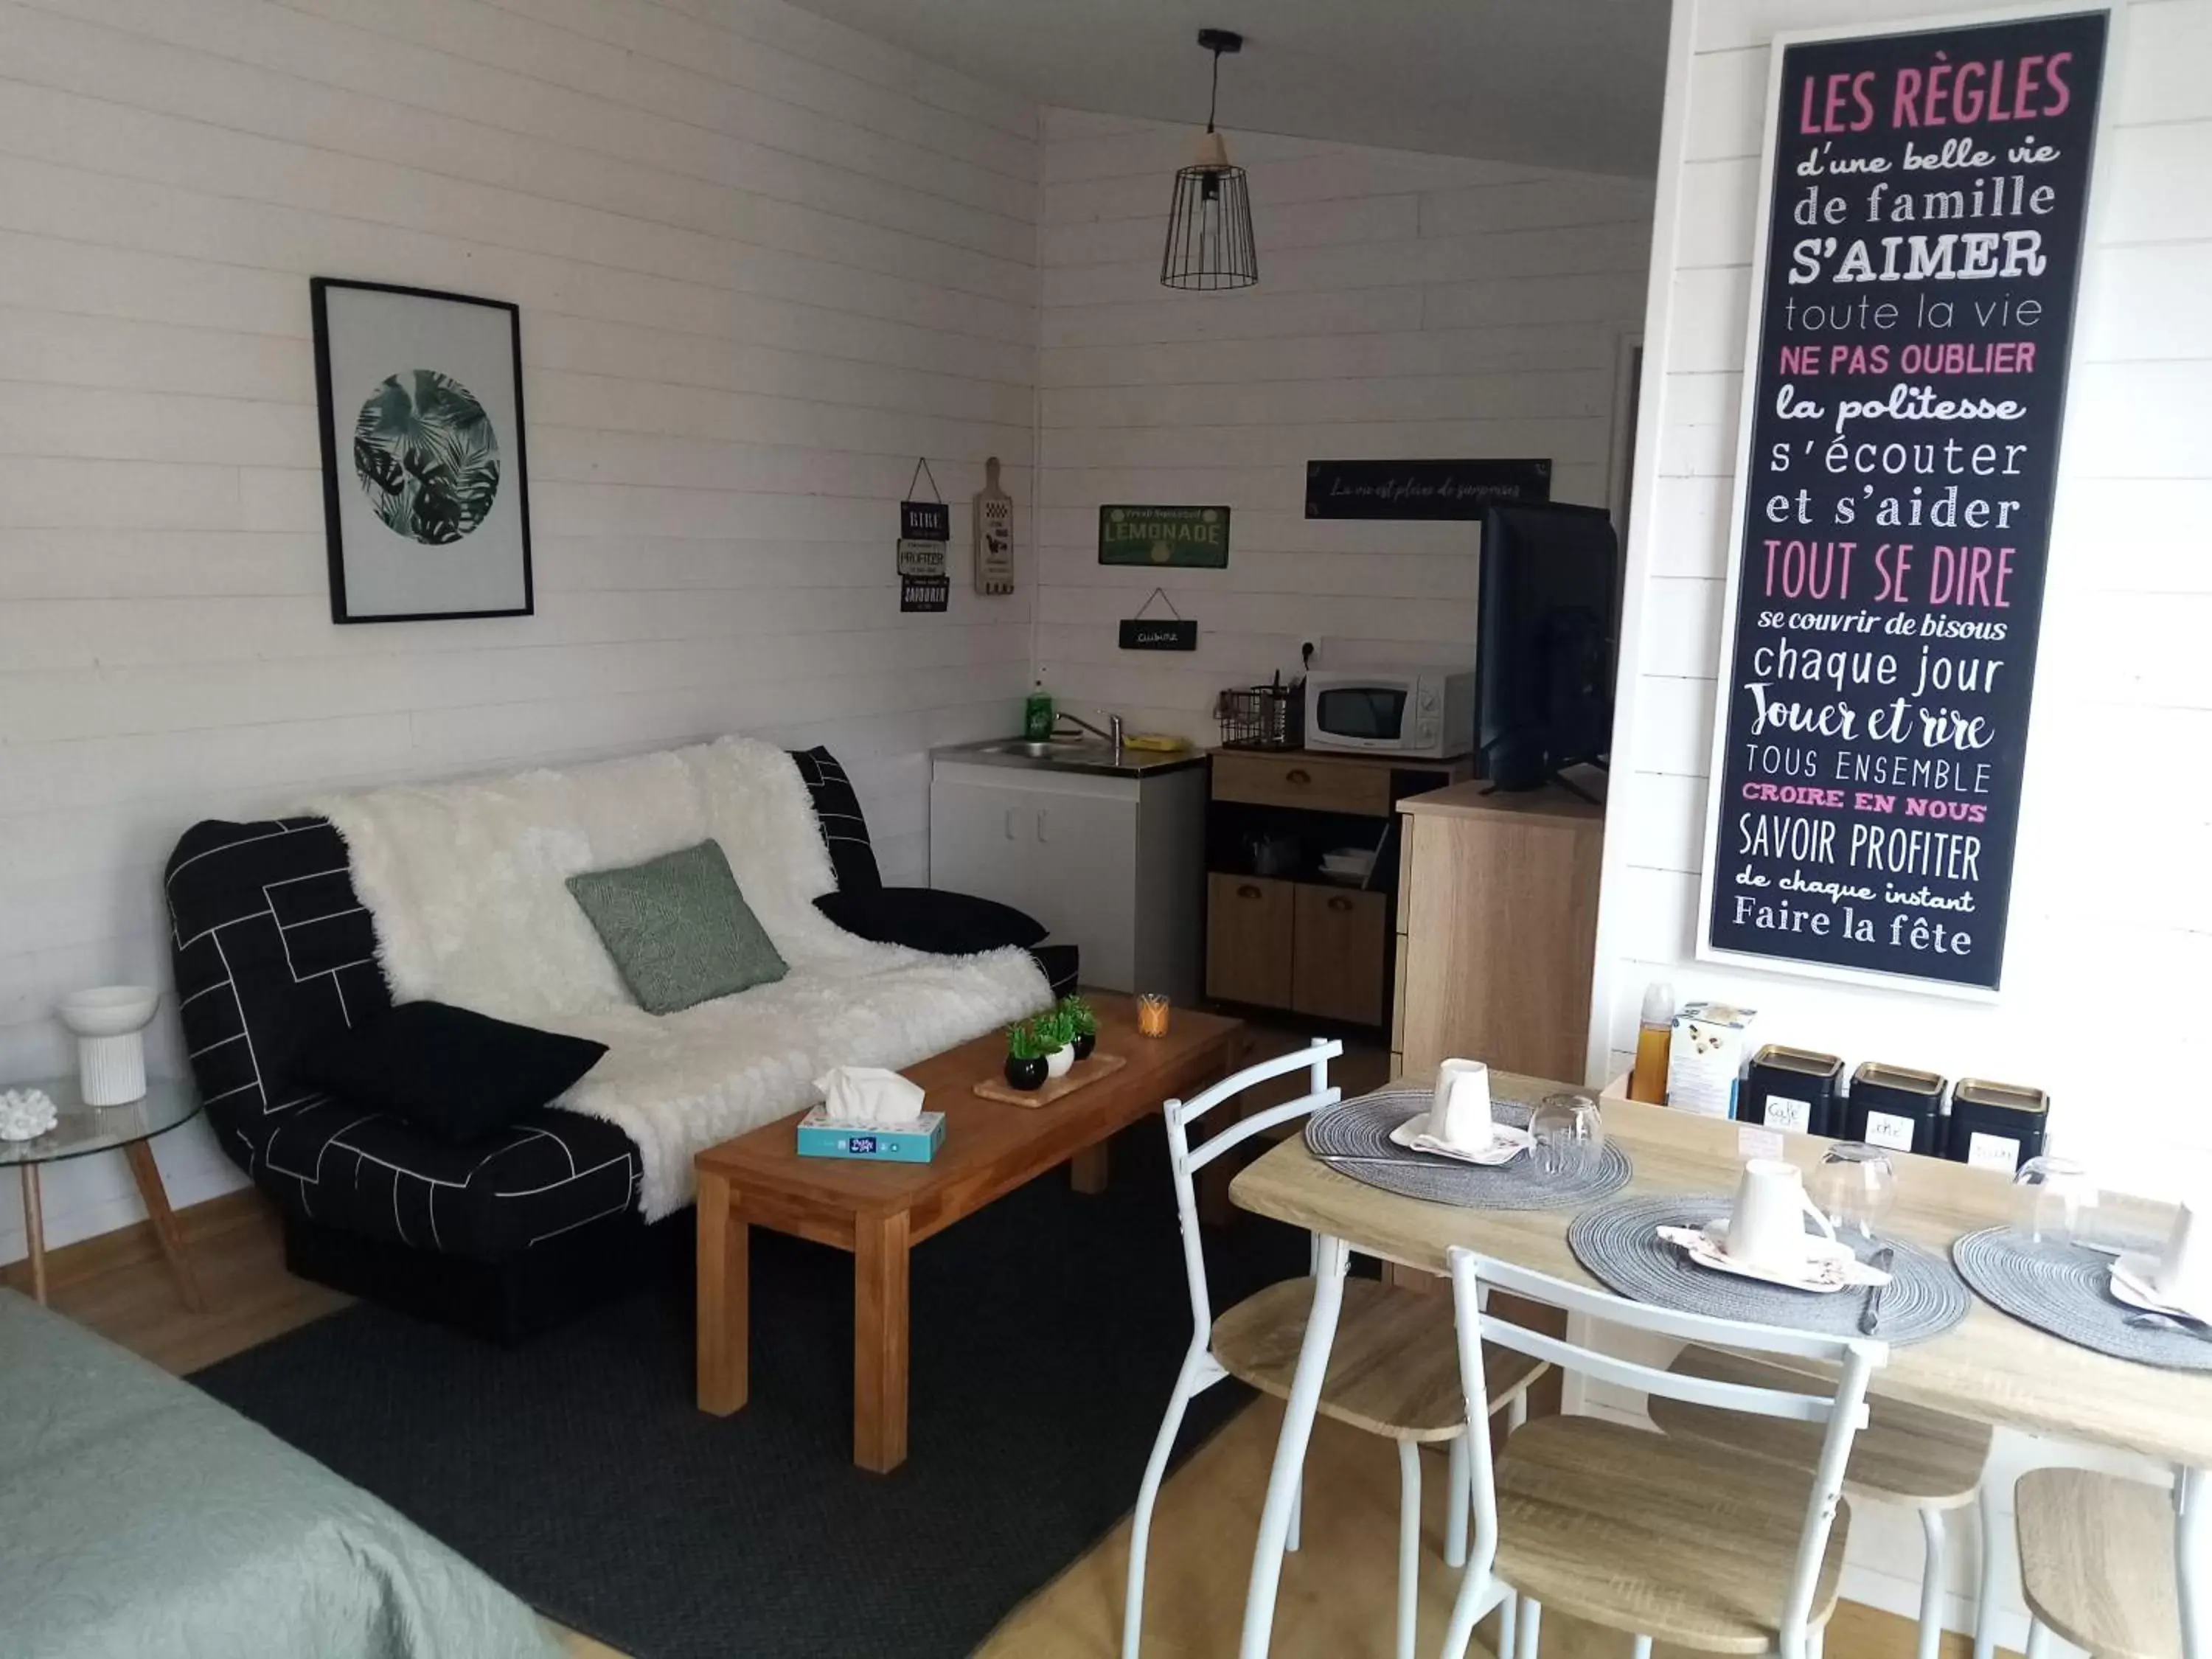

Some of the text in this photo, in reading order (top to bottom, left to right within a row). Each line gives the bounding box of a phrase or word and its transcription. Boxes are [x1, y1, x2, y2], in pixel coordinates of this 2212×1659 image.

[1801, 52, 2071, 133] LES RÈGLES
[1797, 136, 2060, 175] d'une belle vie
[1795, 175, 2054, 225] de famille
[1789, 230, 2046, 284] S'AIMER
[1786, 293, 2042, 330] toute la vie
[1781, 342, 2035, 375] NE PAS OUBLIER
[1777, 383, 2026, 434] la politesse
[1771, 435, 2027, 475] s'écouter
[1767, 485, 2020, 528] et s'aider
[1105, 521, 1221, 546] LEMONADE
[1764, 540, 2015, 608] TOUT SE DIRE
[1758, 610, 2007, 640] se couvrir de bisous
[1755, 637, 2003, 697] chaque jour
[1745, 683, 1994, 750] Jouer et rire
[1747, 744, 1991, 793] TOUS ENSEMBLE
[1743, 783, 1987, 822] CROIRE EN NOUS
[1740, 813, 1980, 881] SAVOIR PROFITER
[1736, 864, 1975, 912] de chaque instant
[1733, 896, 1971, 954] Faire la fête
